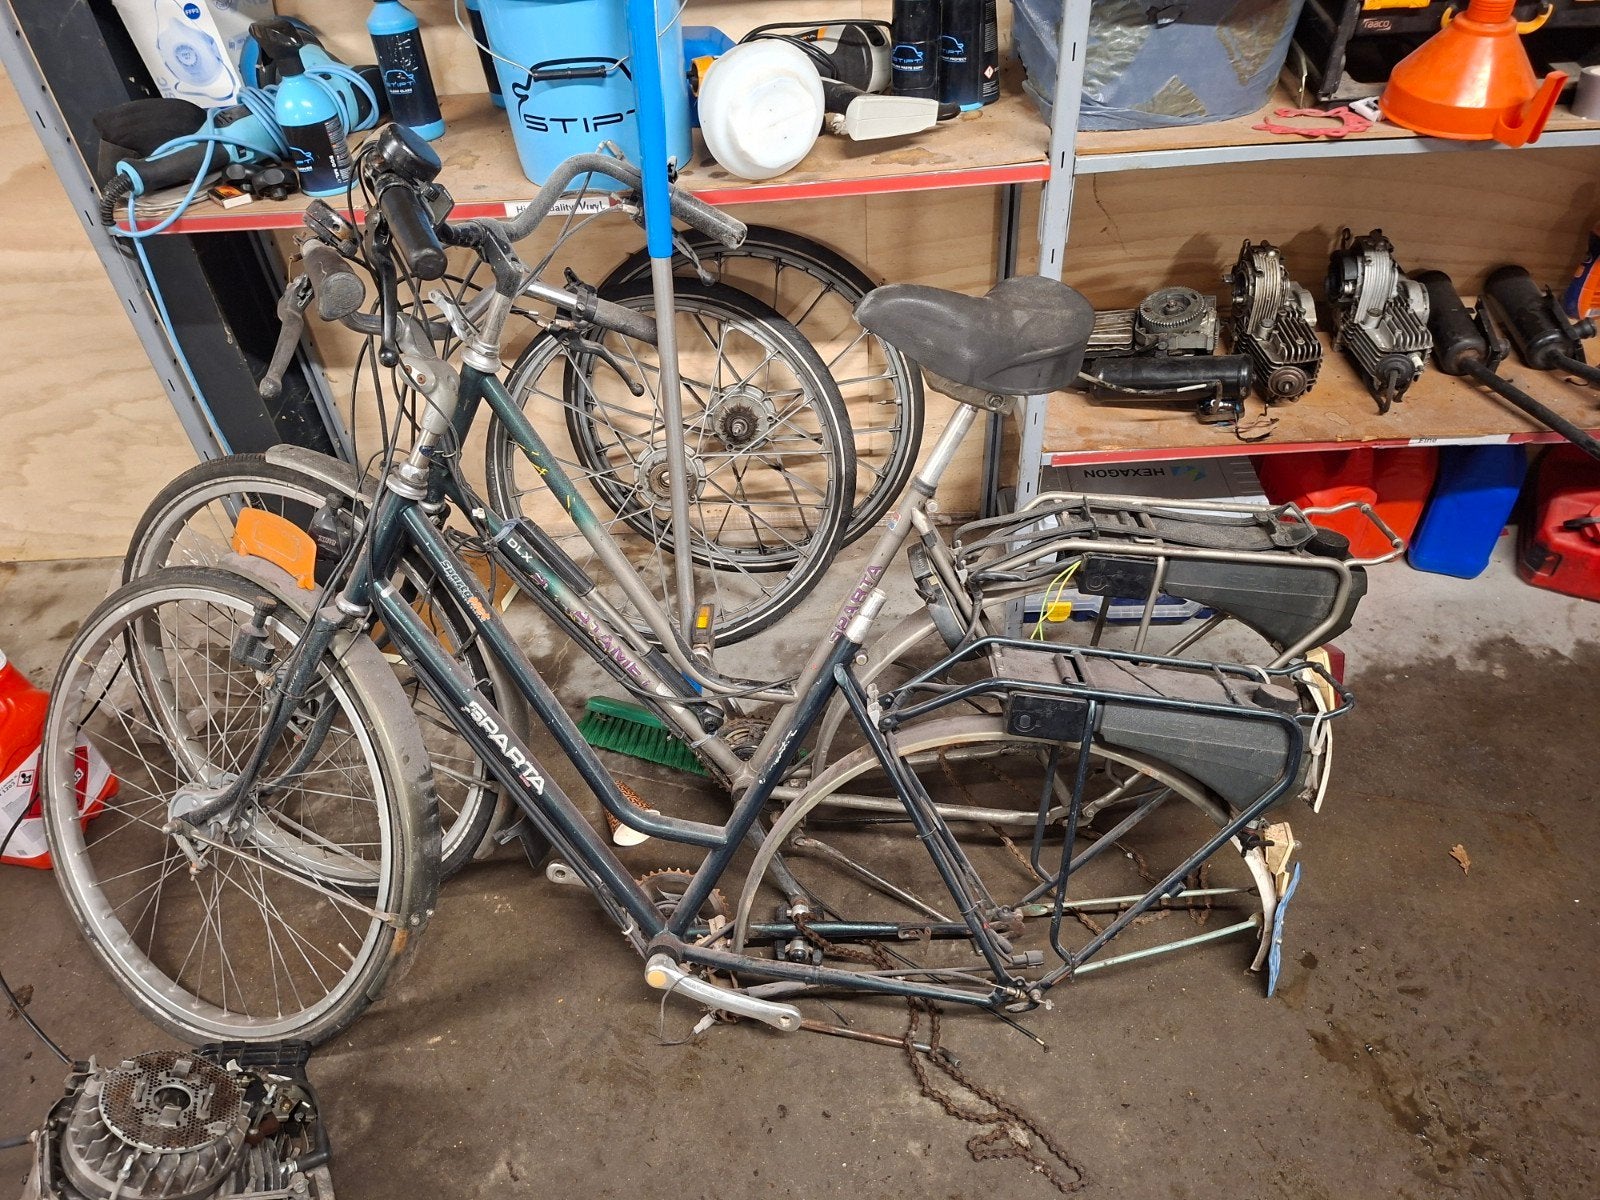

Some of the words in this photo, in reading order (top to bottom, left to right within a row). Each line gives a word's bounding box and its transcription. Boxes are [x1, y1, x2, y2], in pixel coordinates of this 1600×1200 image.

[523, 109, 636, 133] STIP
[1083, 467, 1165, 479] HEXAGON
[506, 537, 533, 563] DLX
[829, 565, 882, 642] SPARTA
[467, 700, 544, 796] SPARTA
